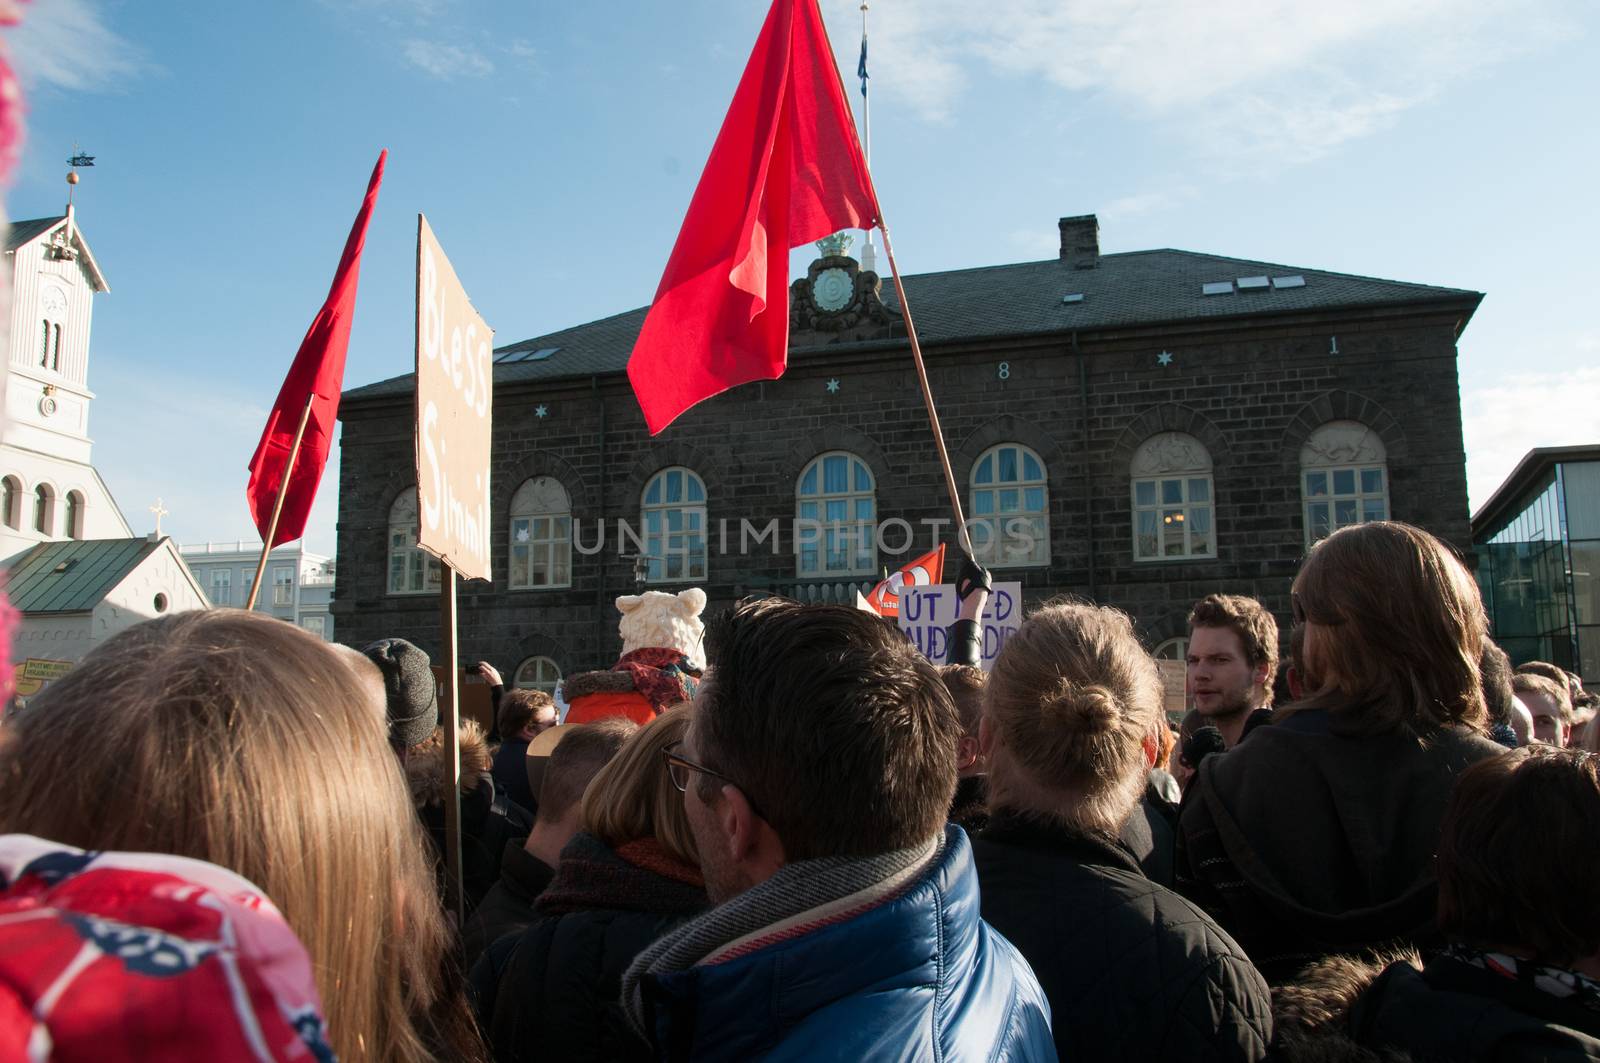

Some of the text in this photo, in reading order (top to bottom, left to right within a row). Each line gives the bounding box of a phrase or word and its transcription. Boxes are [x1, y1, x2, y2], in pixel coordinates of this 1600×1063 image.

[1329, 336, 1339, 354] 1
[999, 362, 1010, 379] 8
[905, 590, 942, 621] ÚT
